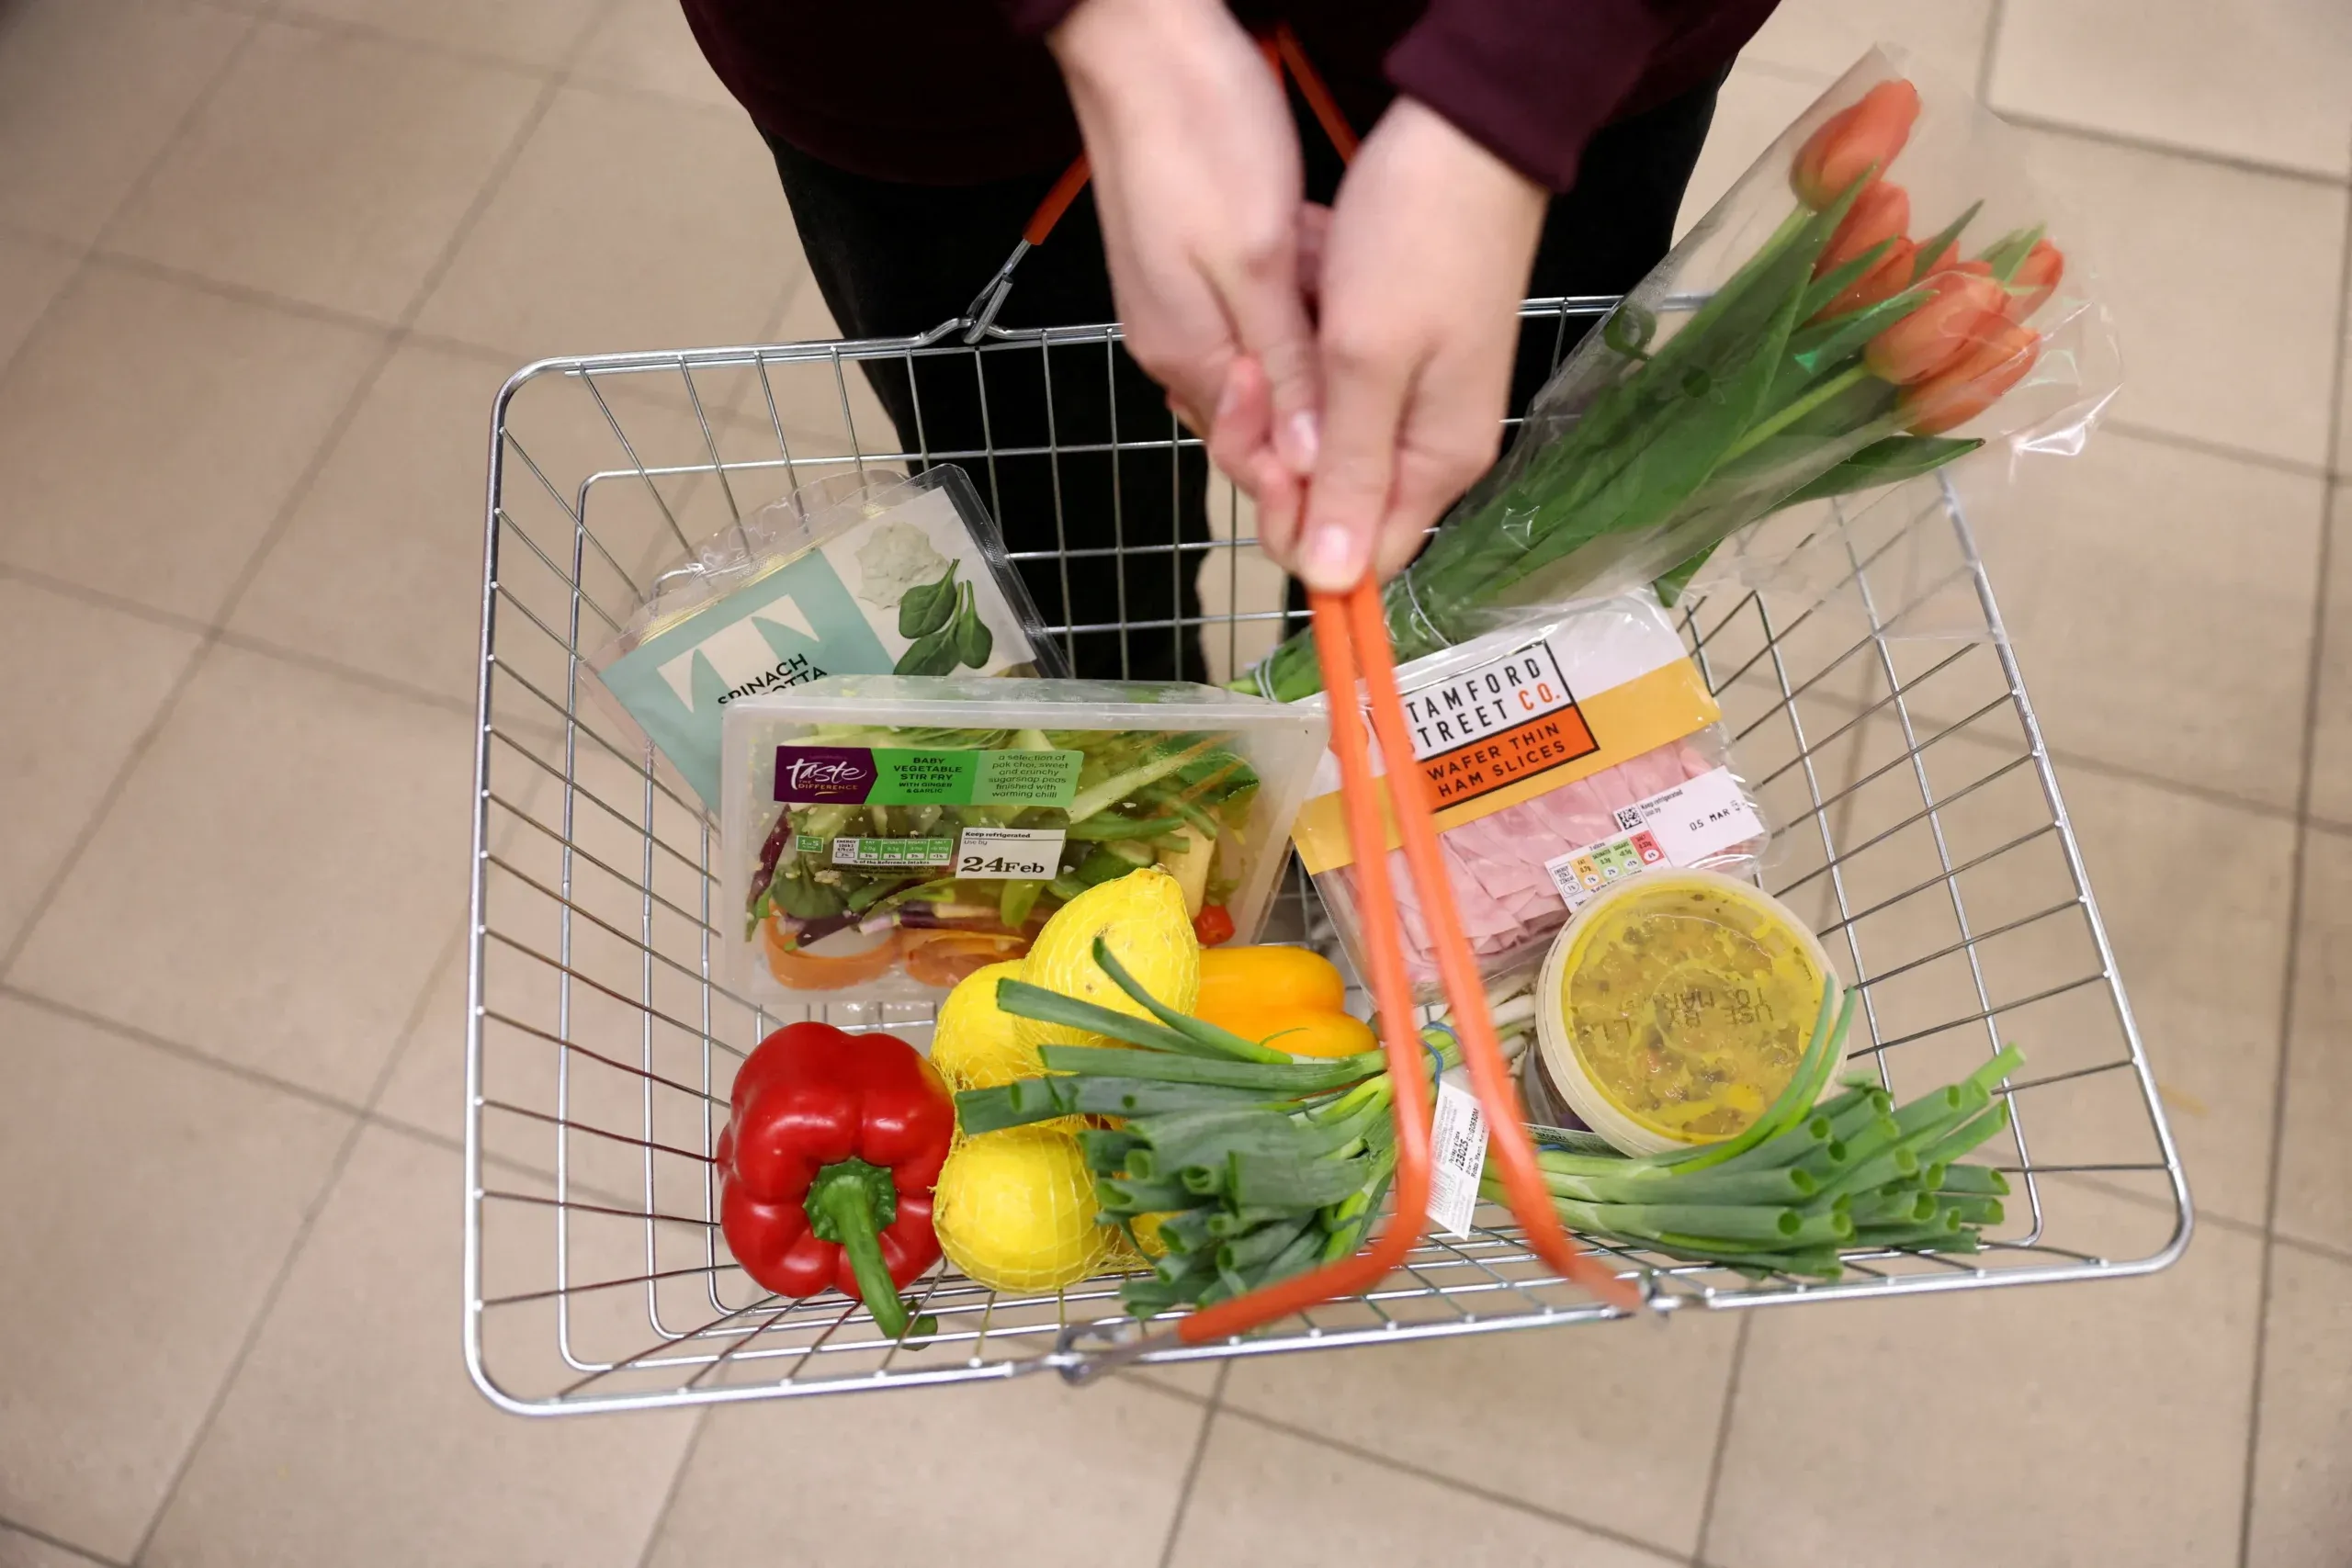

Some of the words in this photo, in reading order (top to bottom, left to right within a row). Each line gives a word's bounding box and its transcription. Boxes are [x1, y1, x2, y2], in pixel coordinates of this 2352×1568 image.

[718, 653, 808, 705] SPINACH
[1406, 658, 1541, 723] TAMFORD
[1411, 699, 1508, 751] TREET
[1518, 682, 1560, 711] CO.
[786, 758, 867, 790] taste
[893, 765, 963, 773] VEGETABLE
[1020, 769, 1059, 777] crunchy
[1427, 745, 1502, 781] WAFER
[1509, 722, 1560, 750] THIN
[1438, 772, 1484, 797] HAM
[1492, 740, 1565, 777] SLICES
[1709, 808, 1731, 822] MAR
